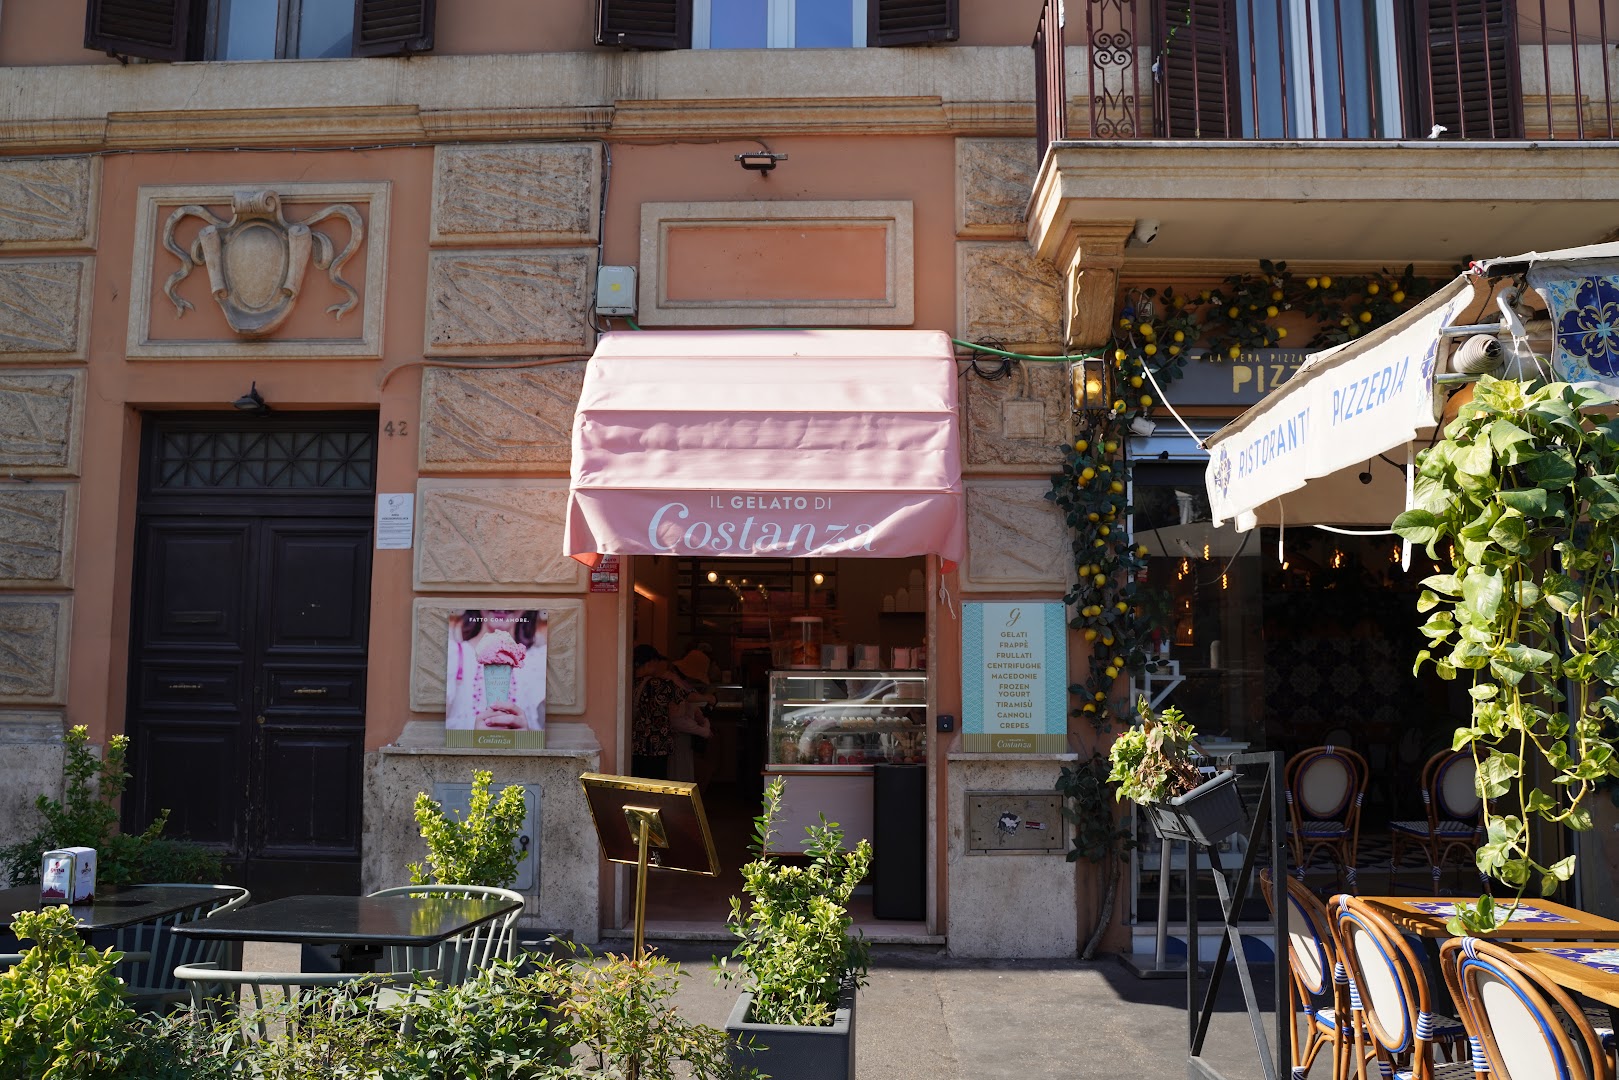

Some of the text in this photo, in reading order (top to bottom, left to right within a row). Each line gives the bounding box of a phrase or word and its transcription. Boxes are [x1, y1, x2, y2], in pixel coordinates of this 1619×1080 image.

[1209, 353, 1222, 363] LA
[1232, 364, 1301, 394] PIZ
[1332, 356, 1410, 427] PIZZERIA
[384, 420, 408, 437] 42
[709, 495, 832, 510] IL GELATO DI
[647, 502, 877, 553] Costanza
[999, 640, 1029, 649] FRAPPÈ
[996, 699, 1033, 708] TIRAMISÙ
